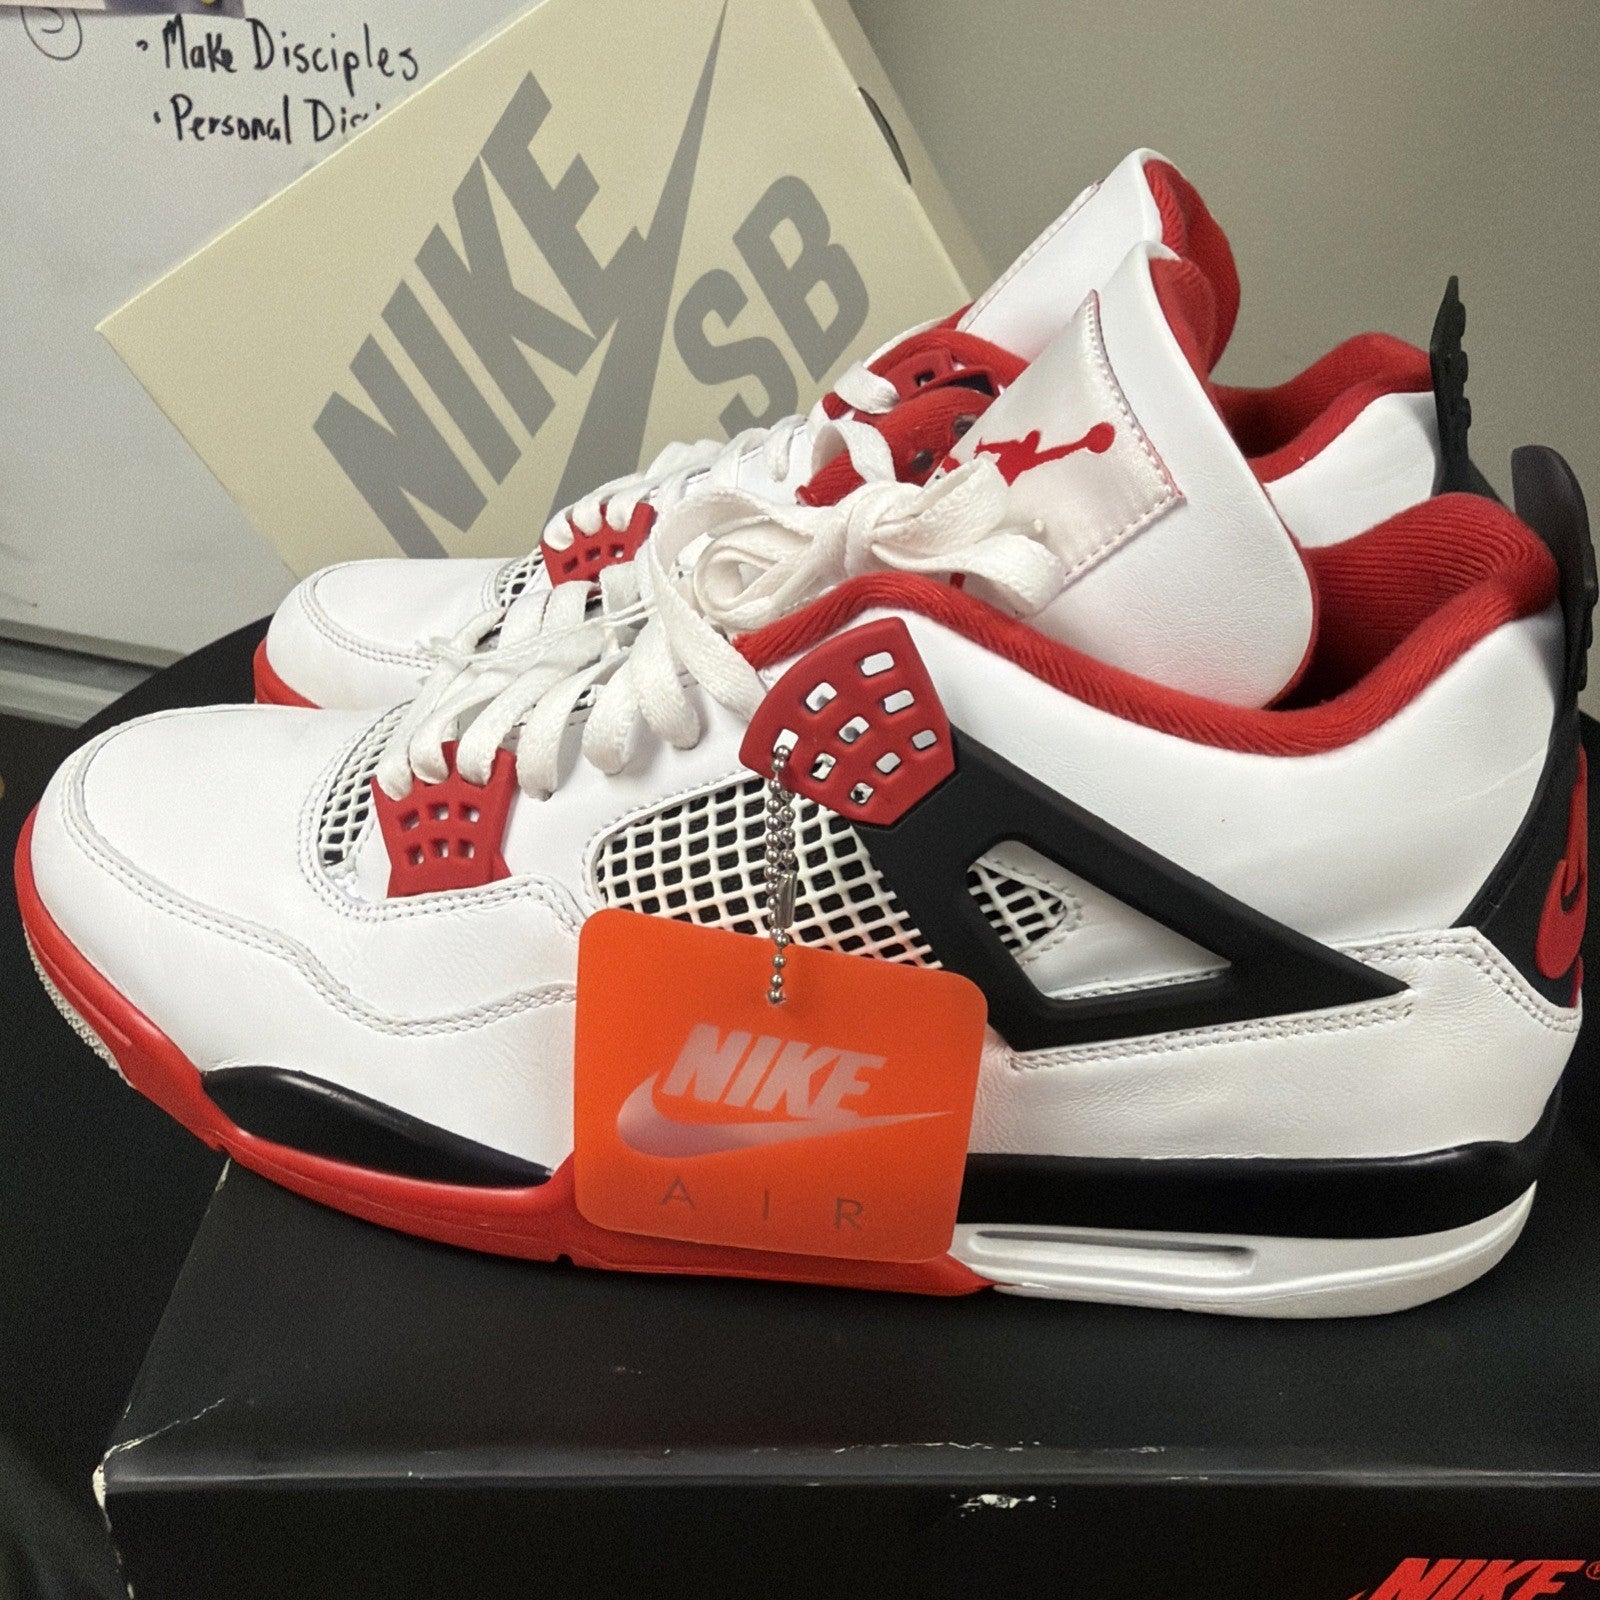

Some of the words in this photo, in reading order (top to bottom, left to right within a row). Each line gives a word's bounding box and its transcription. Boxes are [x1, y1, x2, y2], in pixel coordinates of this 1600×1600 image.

[162, 13, 238, 73] Make
[246, 17, 419, 97] Disciples
[169, 93, 292, 145] Personal
[312, 69, 650, 559] NIKE
[672, 174, 870, 442] SB
[660, 1022, 888, 1120] NIKE
[659, 1175, 865, 1230] AIR
[1367, 1557, 1587, 1600] NIKE
